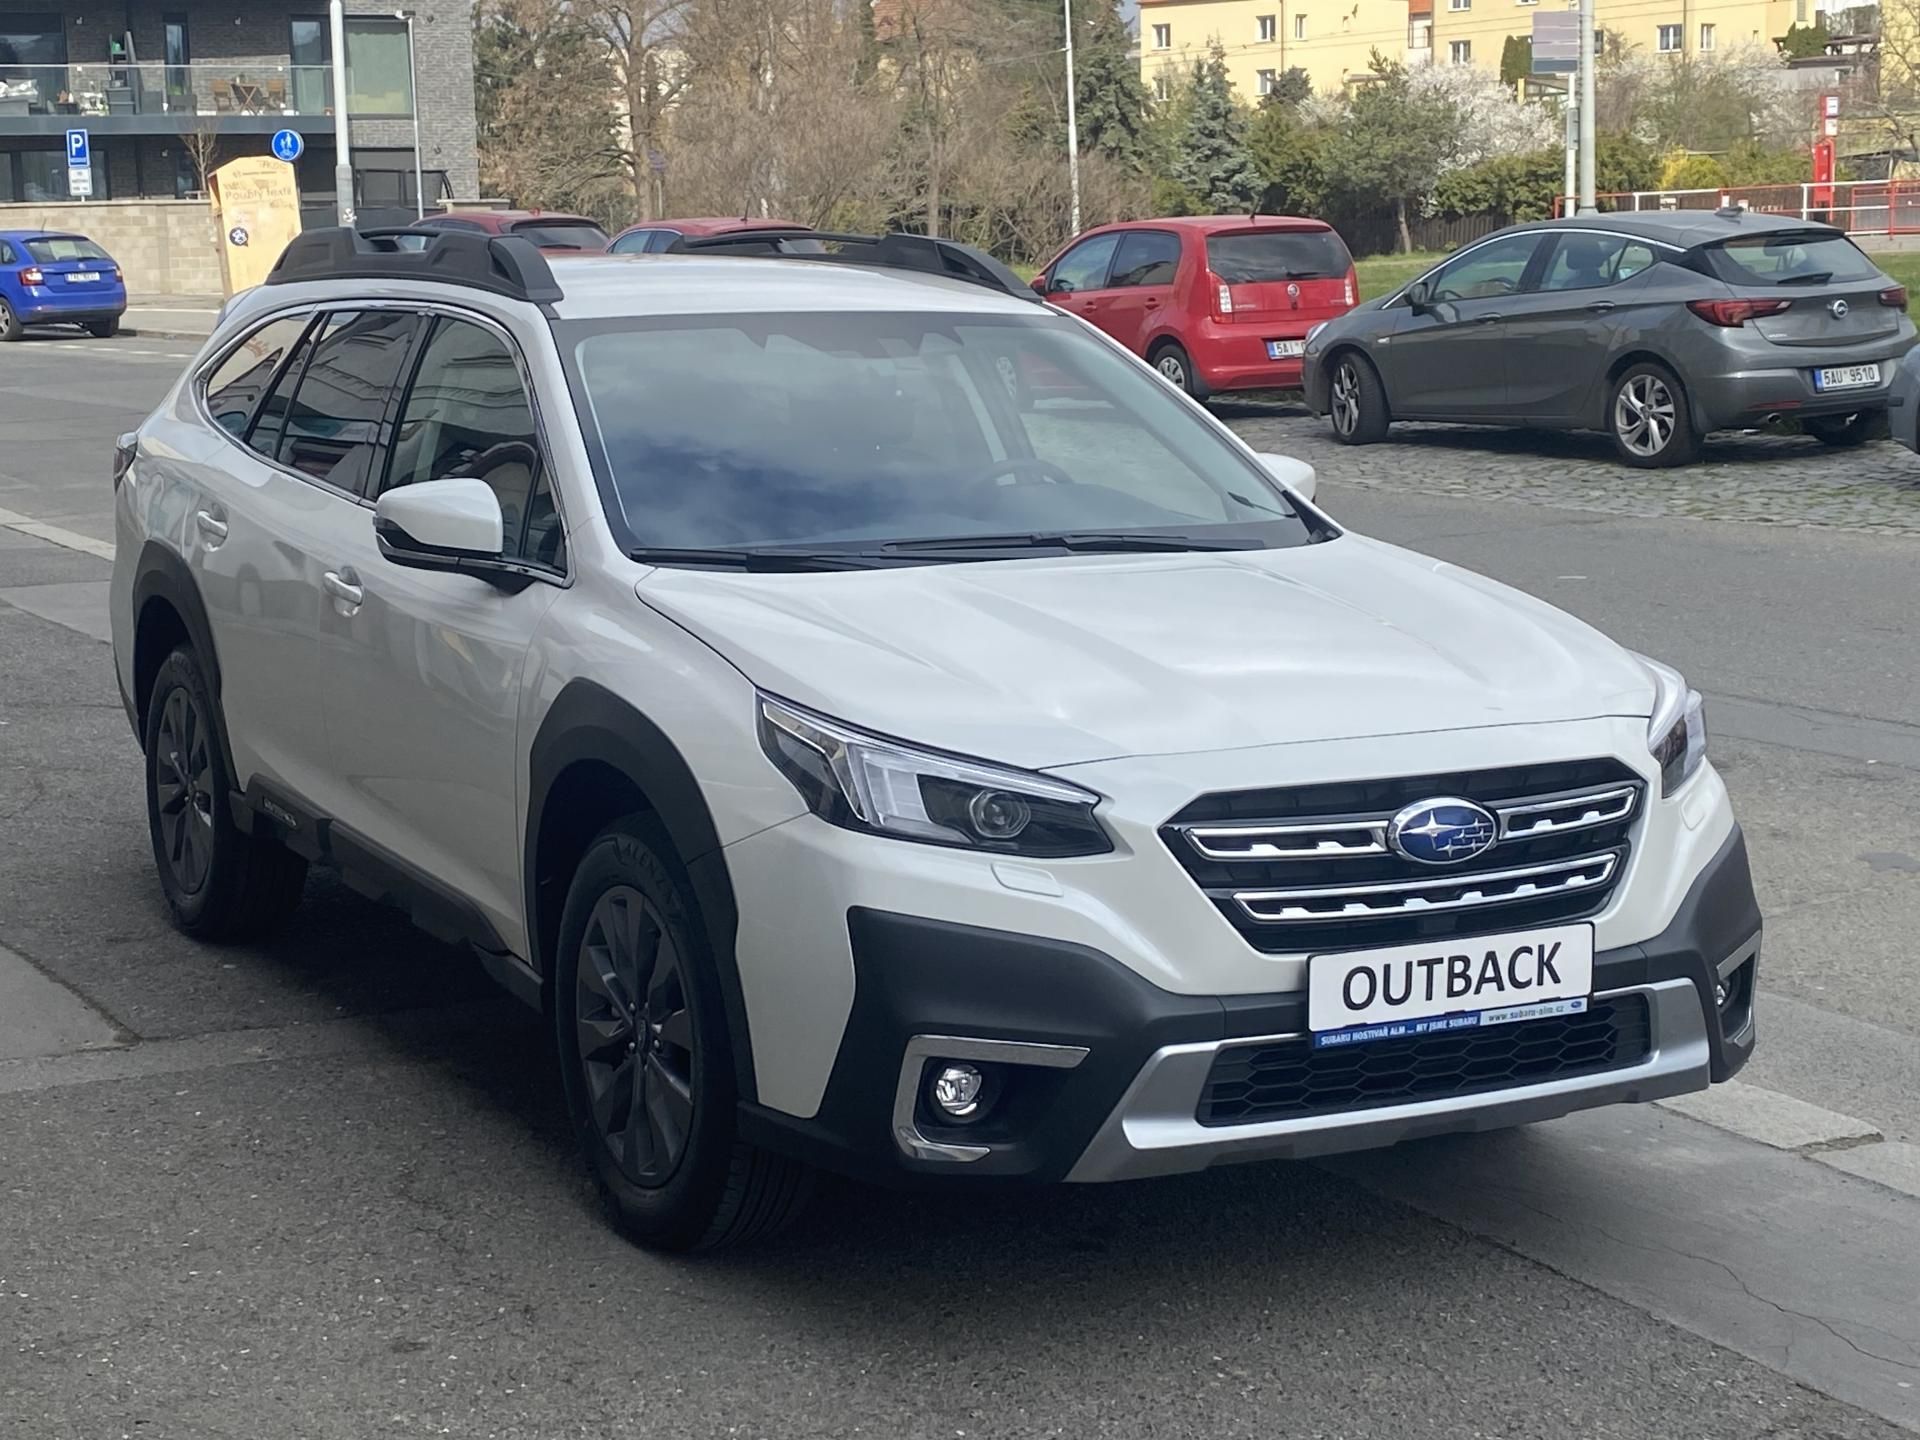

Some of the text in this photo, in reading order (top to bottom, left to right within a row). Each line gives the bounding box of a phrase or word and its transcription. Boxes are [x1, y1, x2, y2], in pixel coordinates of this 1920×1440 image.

[71, 134, 83, 156] P
[1824, 366, 1875, 385] 5AU 9510
[1342, 941, 1562, 1011] OUTBACK
[1321, 1033, 1351, 1045] SUBARU
[1352, 1026, 1388, 1040] HOSTIVAŘ
[1390, 1026, 1405, 1036] ALM
[1416, 1023, 1428, 1032] MY
[1429, 1020, 1448, 1033] JSME
[1449, 1016, 1478, 1028] SUBARU
